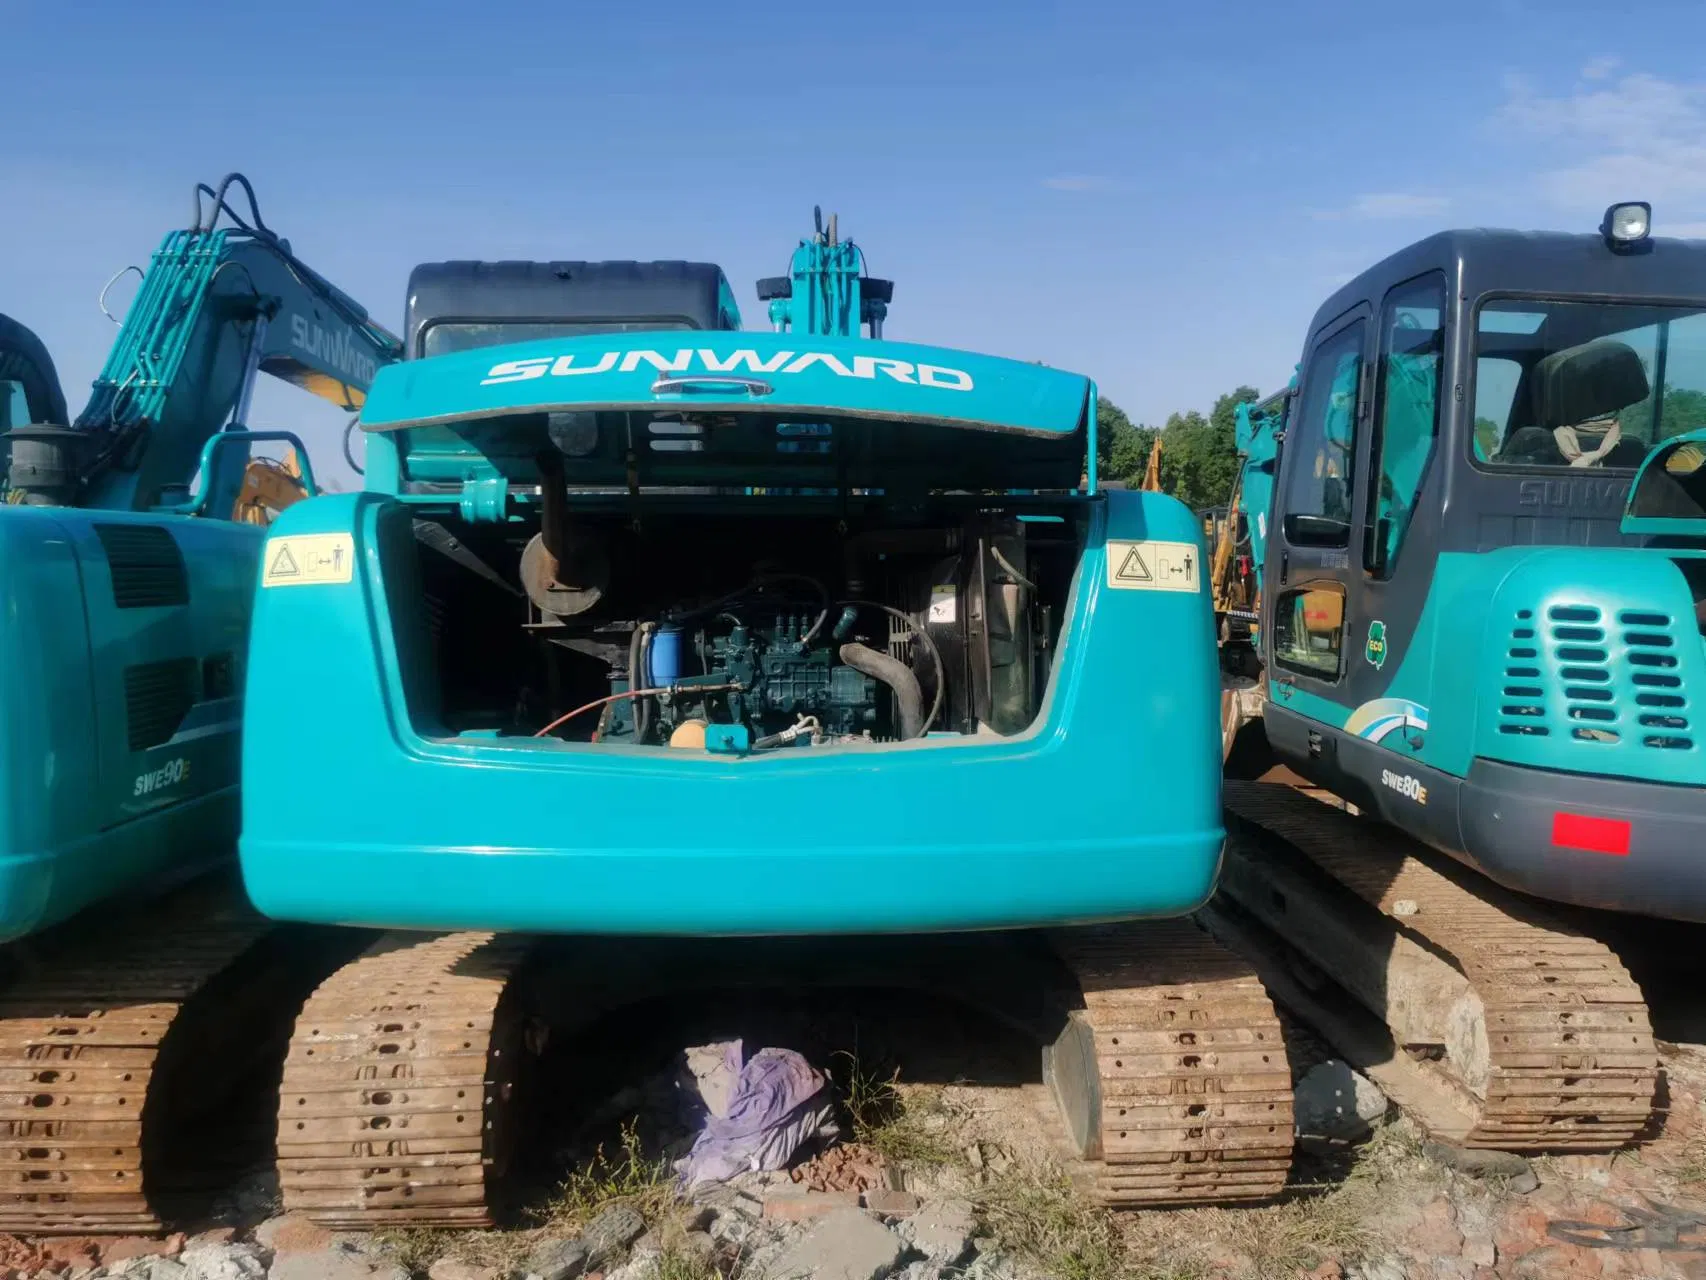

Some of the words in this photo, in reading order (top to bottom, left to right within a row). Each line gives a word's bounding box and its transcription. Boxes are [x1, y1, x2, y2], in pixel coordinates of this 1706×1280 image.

[480, 348, 974, 391] SUNWARD
[1369, 640, 1383, 652] ECO
[133, 758, 191, 796] SWE90E
[1382, 769, 1427, 806] SWE80E
